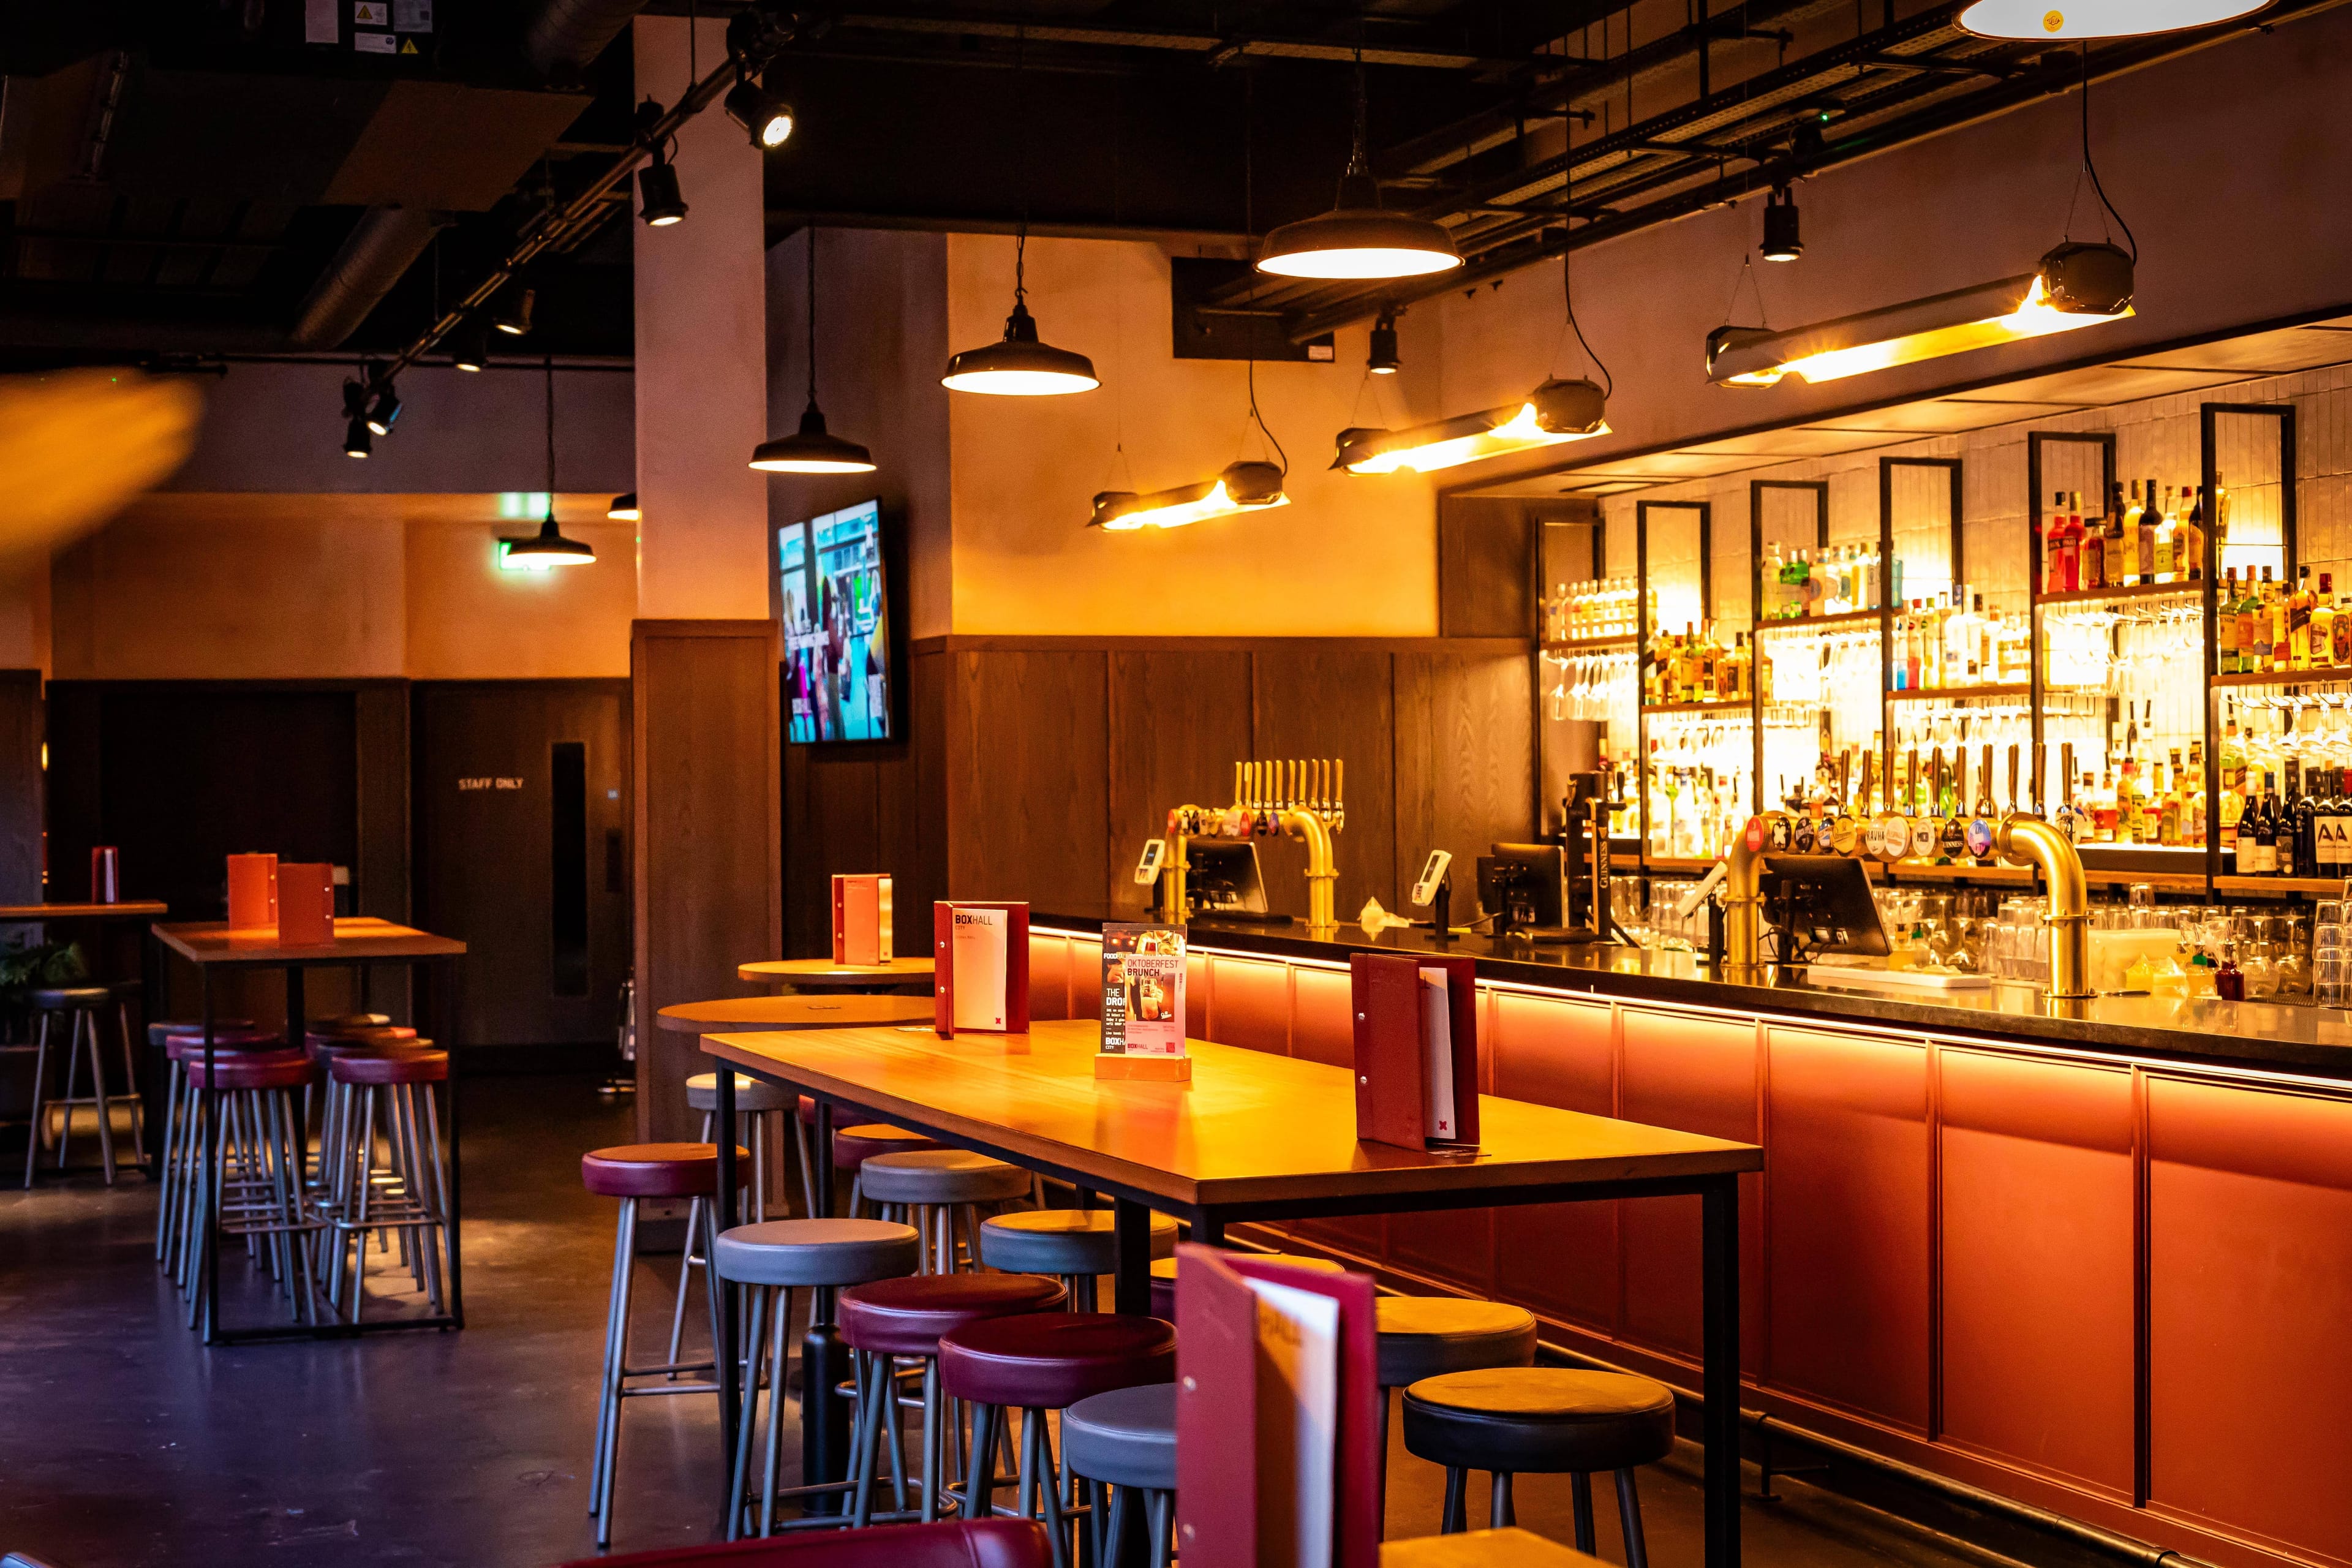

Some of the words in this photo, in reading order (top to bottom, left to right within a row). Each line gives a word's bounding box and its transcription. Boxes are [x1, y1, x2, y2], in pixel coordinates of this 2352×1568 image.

[459, 777, 492, 790] STAFF
[496, 777, 524, 790] ONLY
[1866, 831, 1885, 841] RAVHA
[956, 914, 992, 925] BOXHALL
[1128, 959, 1179, 968] OKTOBERFEST
[1106, 988, 1120, 997] THE
